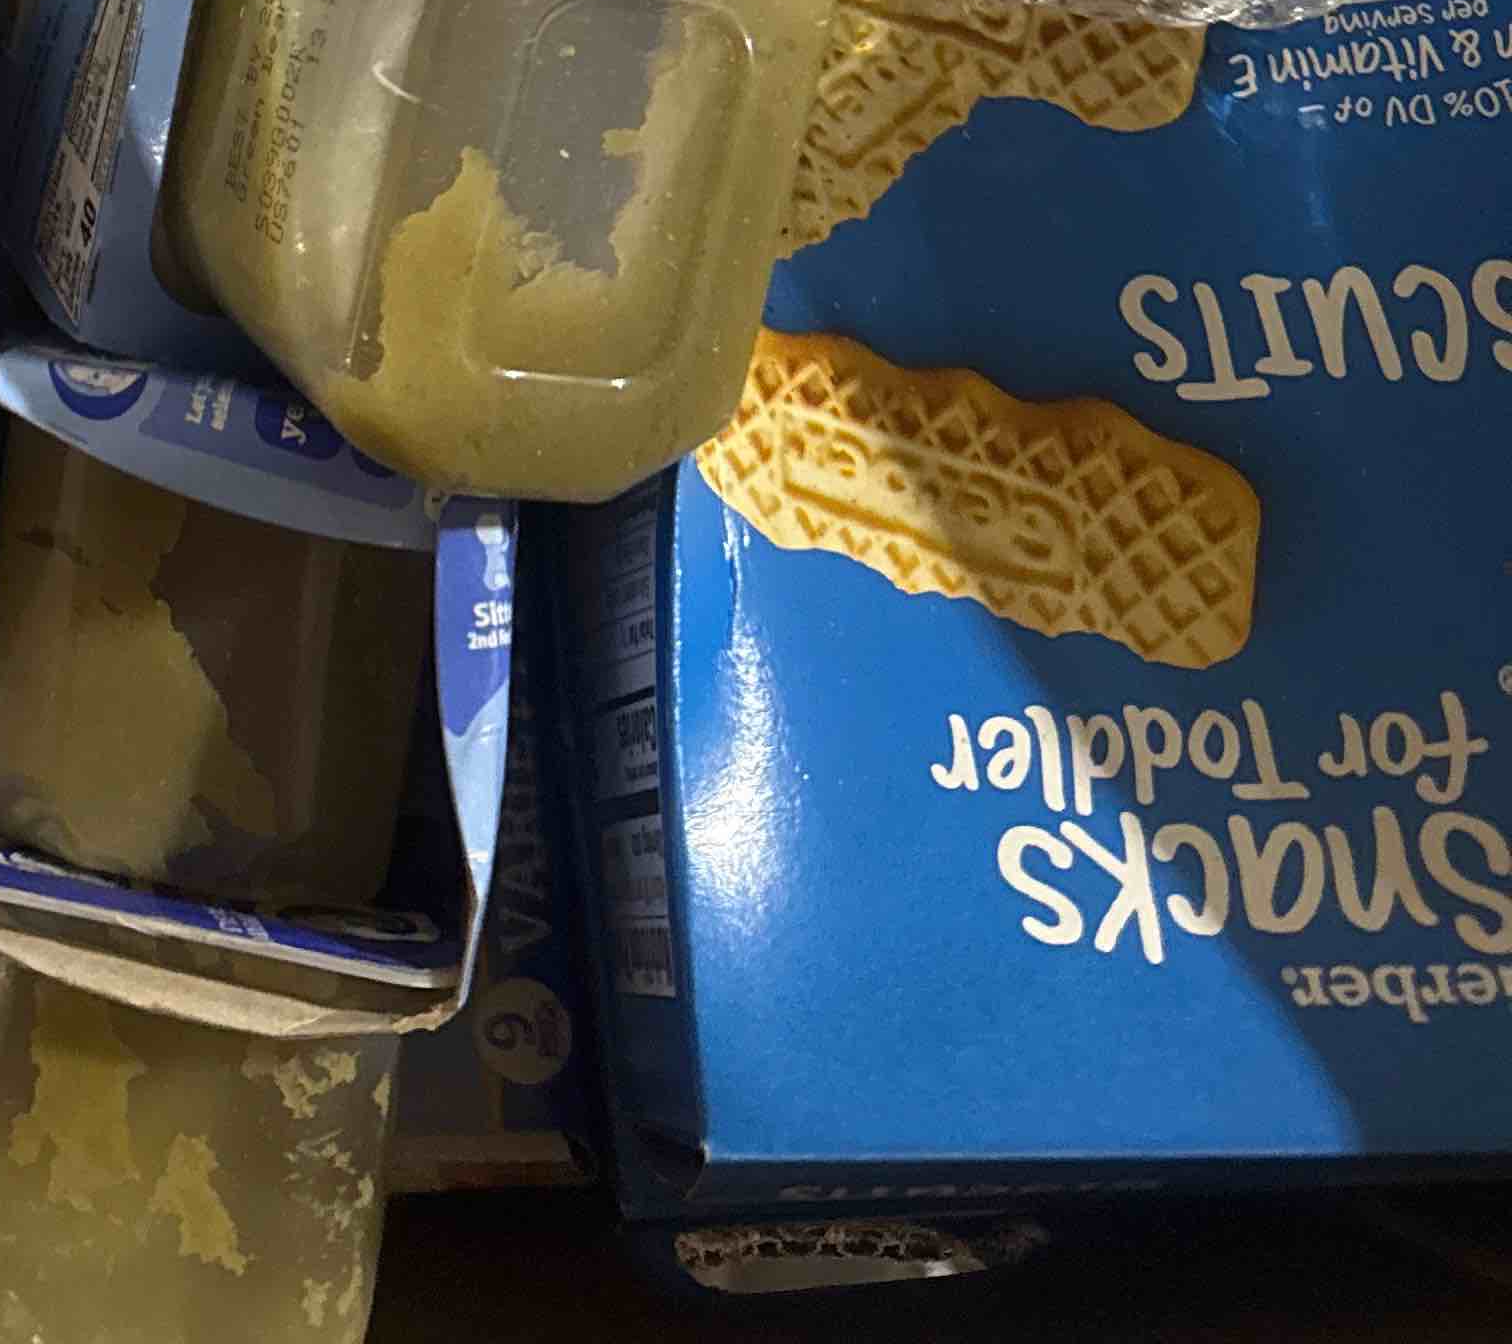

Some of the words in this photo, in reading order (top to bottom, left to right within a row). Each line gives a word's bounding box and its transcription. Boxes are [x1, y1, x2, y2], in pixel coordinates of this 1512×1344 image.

[1323, 6, 1428, 36] serving
[1452, 26, 1486, 53] &
[1229, 53, 1259, 98] E
[1270, 26, 1446, 86] Vitamin
[1333, 93, 1372, 123] of
[1386, 92, 1436, 127] DV
[1117, 258, 1512, 402] SCUITS
[473, 600, 513, 629] Sitt
[468, 630, 496, 650] 2nd
[930, 698, 1310, 815] Toddler
[1317, 689, 1490, 806] for
[995, 806, 1512, 965] Snacks
[1293, 958, 1512, 1024] erber
